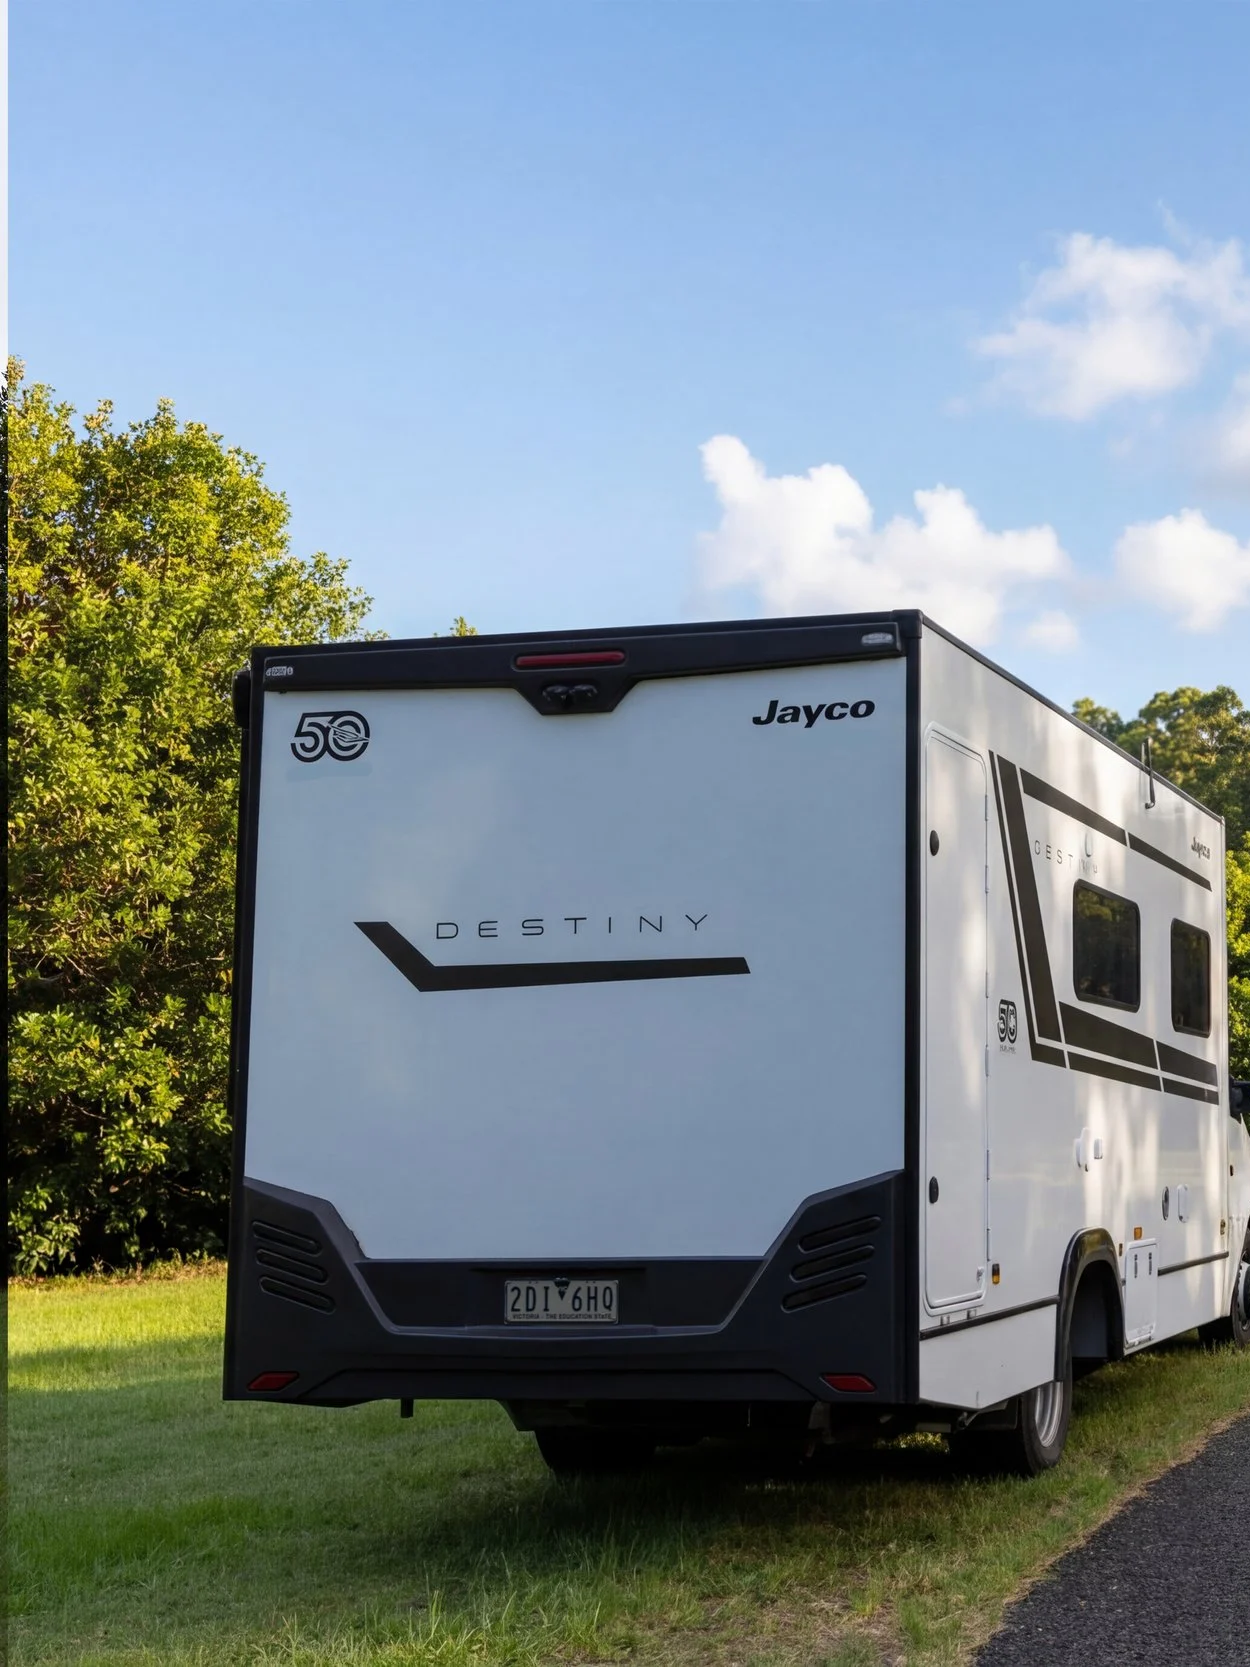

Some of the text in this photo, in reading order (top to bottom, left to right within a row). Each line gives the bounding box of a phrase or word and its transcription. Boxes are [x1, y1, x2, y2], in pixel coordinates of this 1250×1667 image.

[752, 700, 876, 728] Jayco
[290, 710, 370, 763] 50
[436, 914, 708, 939] DESTINY
